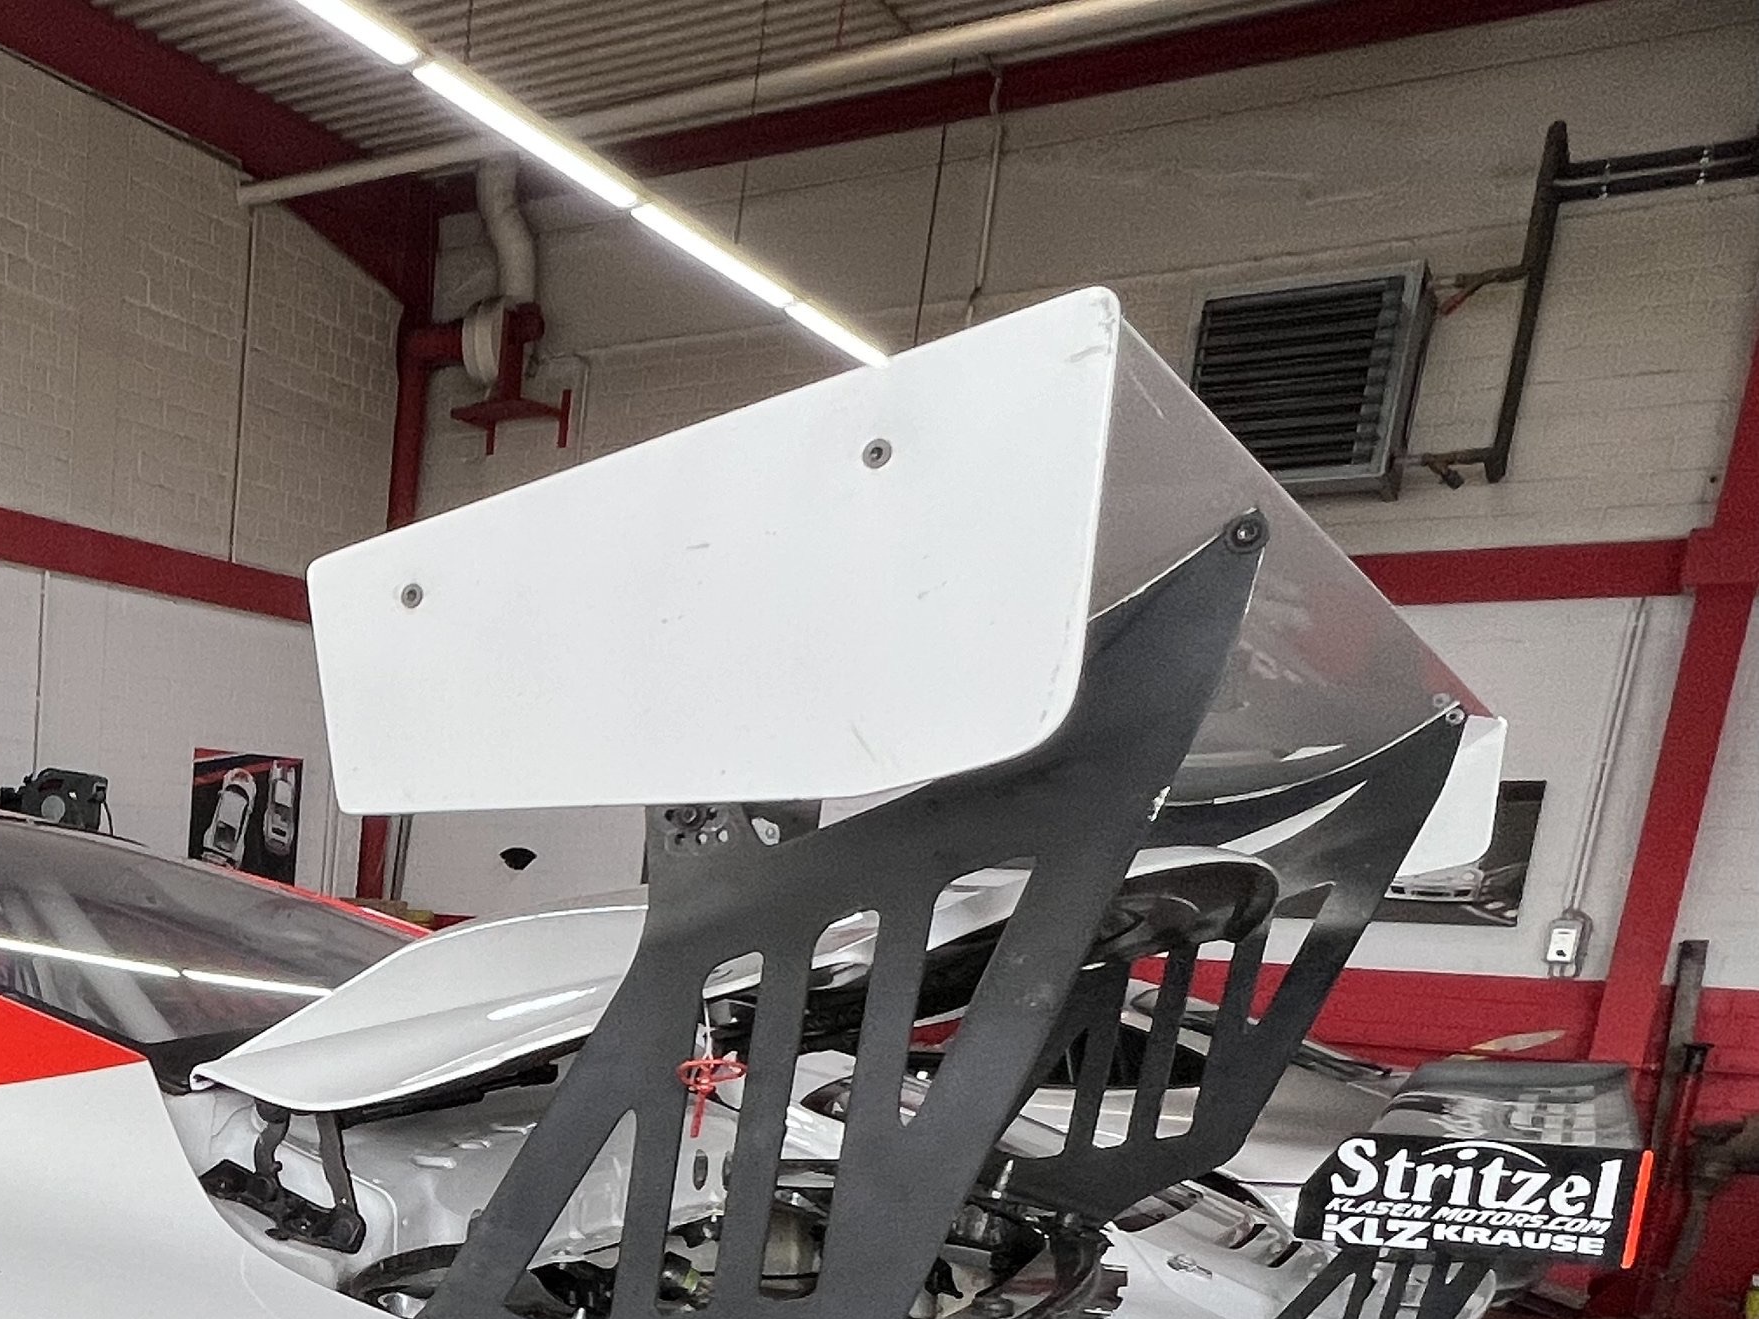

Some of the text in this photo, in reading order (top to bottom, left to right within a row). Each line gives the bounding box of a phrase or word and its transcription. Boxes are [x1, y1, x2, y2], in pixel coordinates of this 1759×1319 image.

[1330, 1137, 1623, 1220] Stritzel
[1322, 1213, 1606, 1255] KLZ KRAUSE
[1324, 1198, 1612, 1235] KLASEN MOTORS.COM
